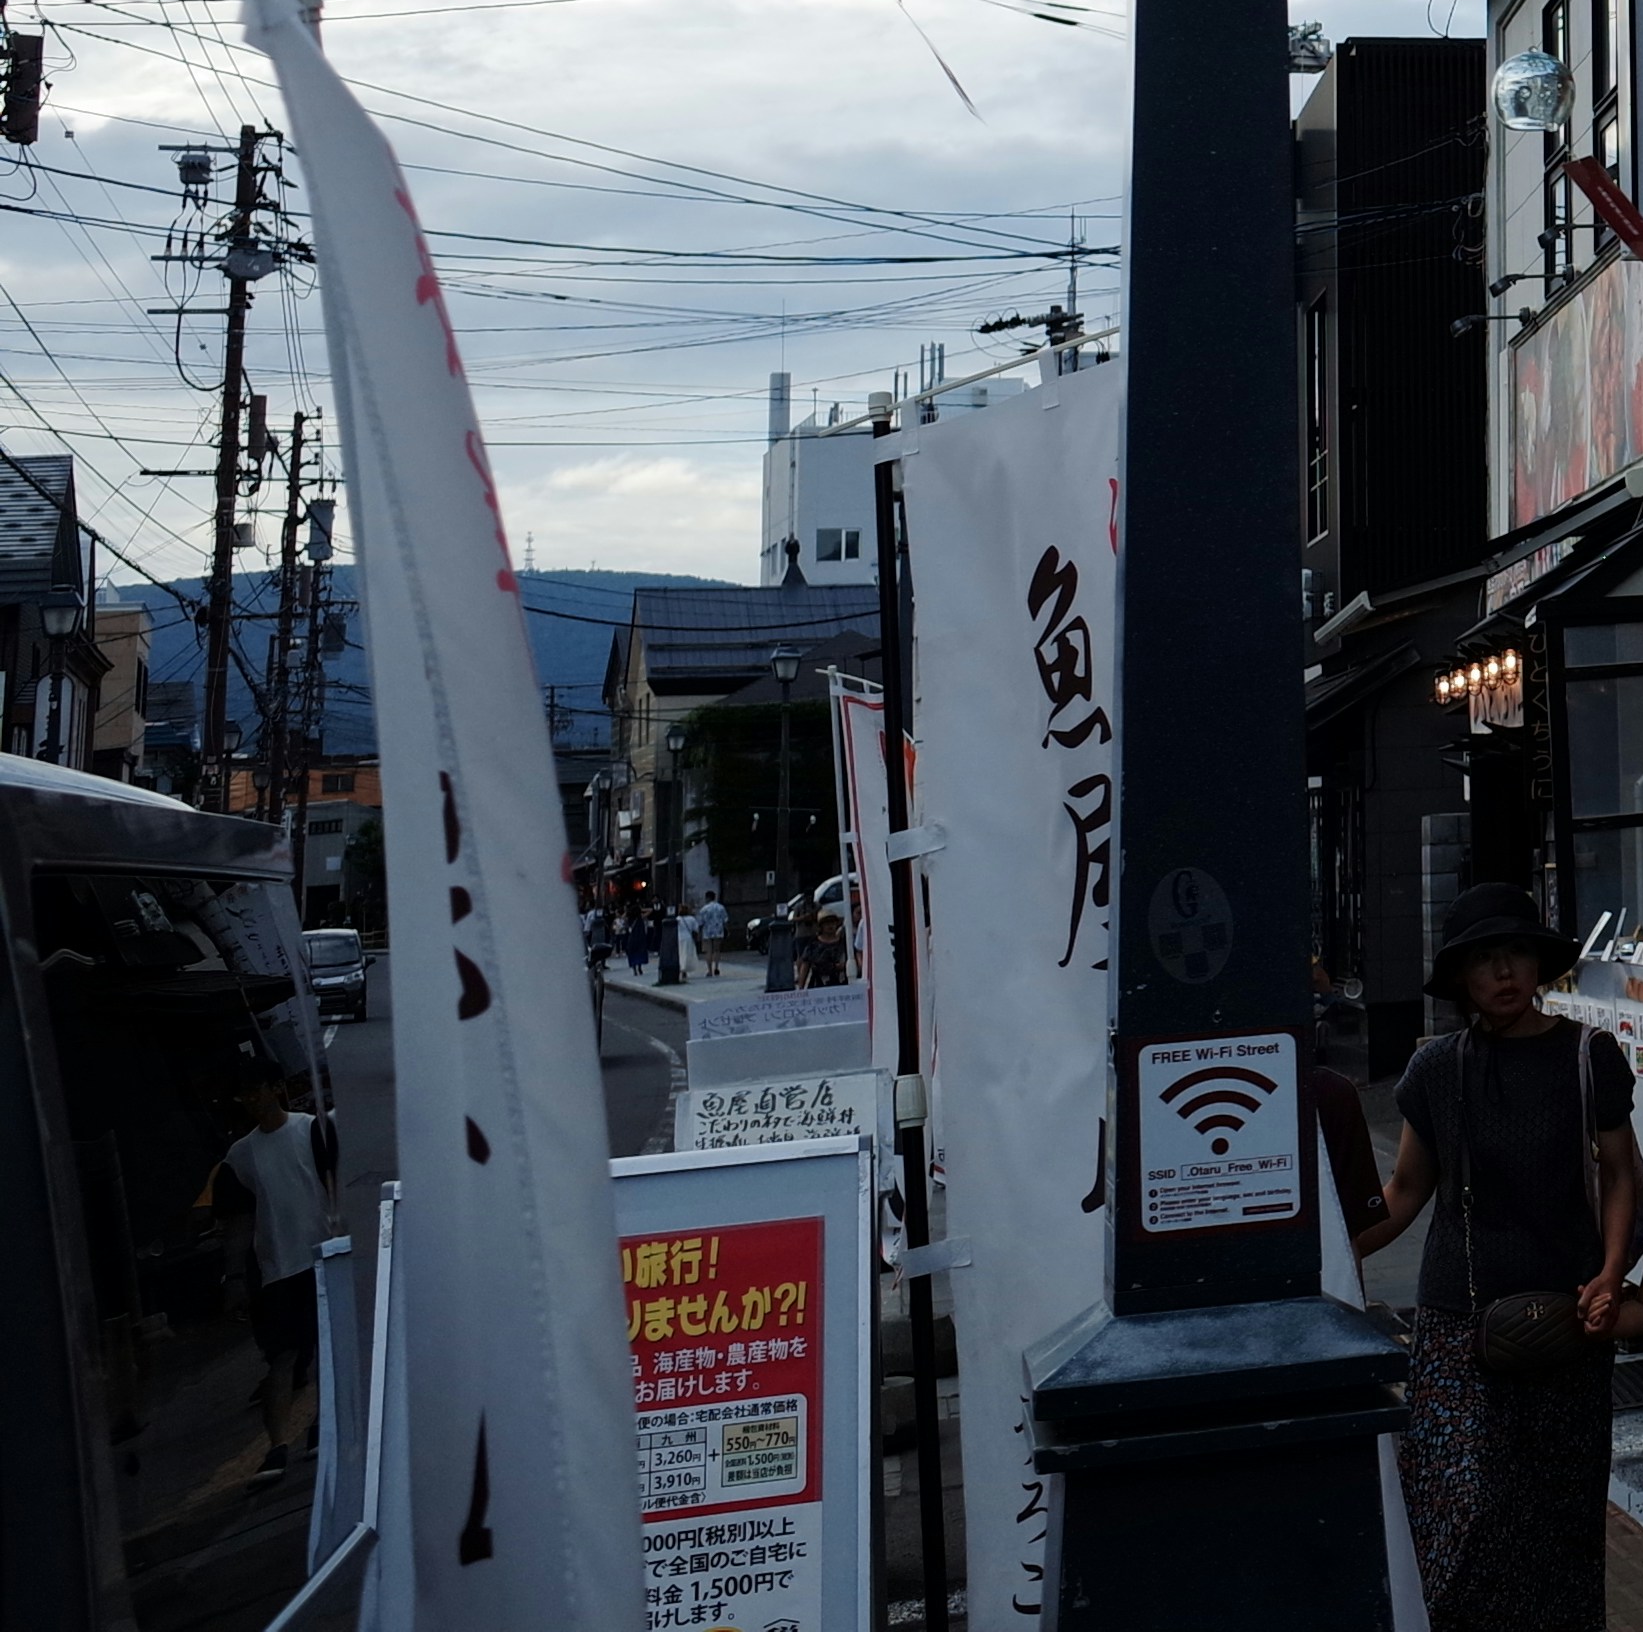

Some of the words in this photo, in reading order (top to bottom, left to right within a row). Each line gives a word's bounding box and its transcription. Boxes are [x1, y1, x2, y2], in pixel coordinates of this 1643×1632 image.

[1152, 1050, 1191, 1064] FREE
[1196, 1047, 1233, 1060] Wi-Fi
[1237, 1043, 1280, 1056] Street
[697, 1079, 833, 1118] 魚屋直営店
[1148, 1169, 1176, 1181] SSID
[653, 1335, 808, 1375] 海産物・農産物を
[635, 1369, 760, 1404] お届けします。
[655, 1450, 701, 1467] 3,260円
[654, 1472, 701, 1490] 3,910円
[690, 1569, 795, 1603] 1,500円で
